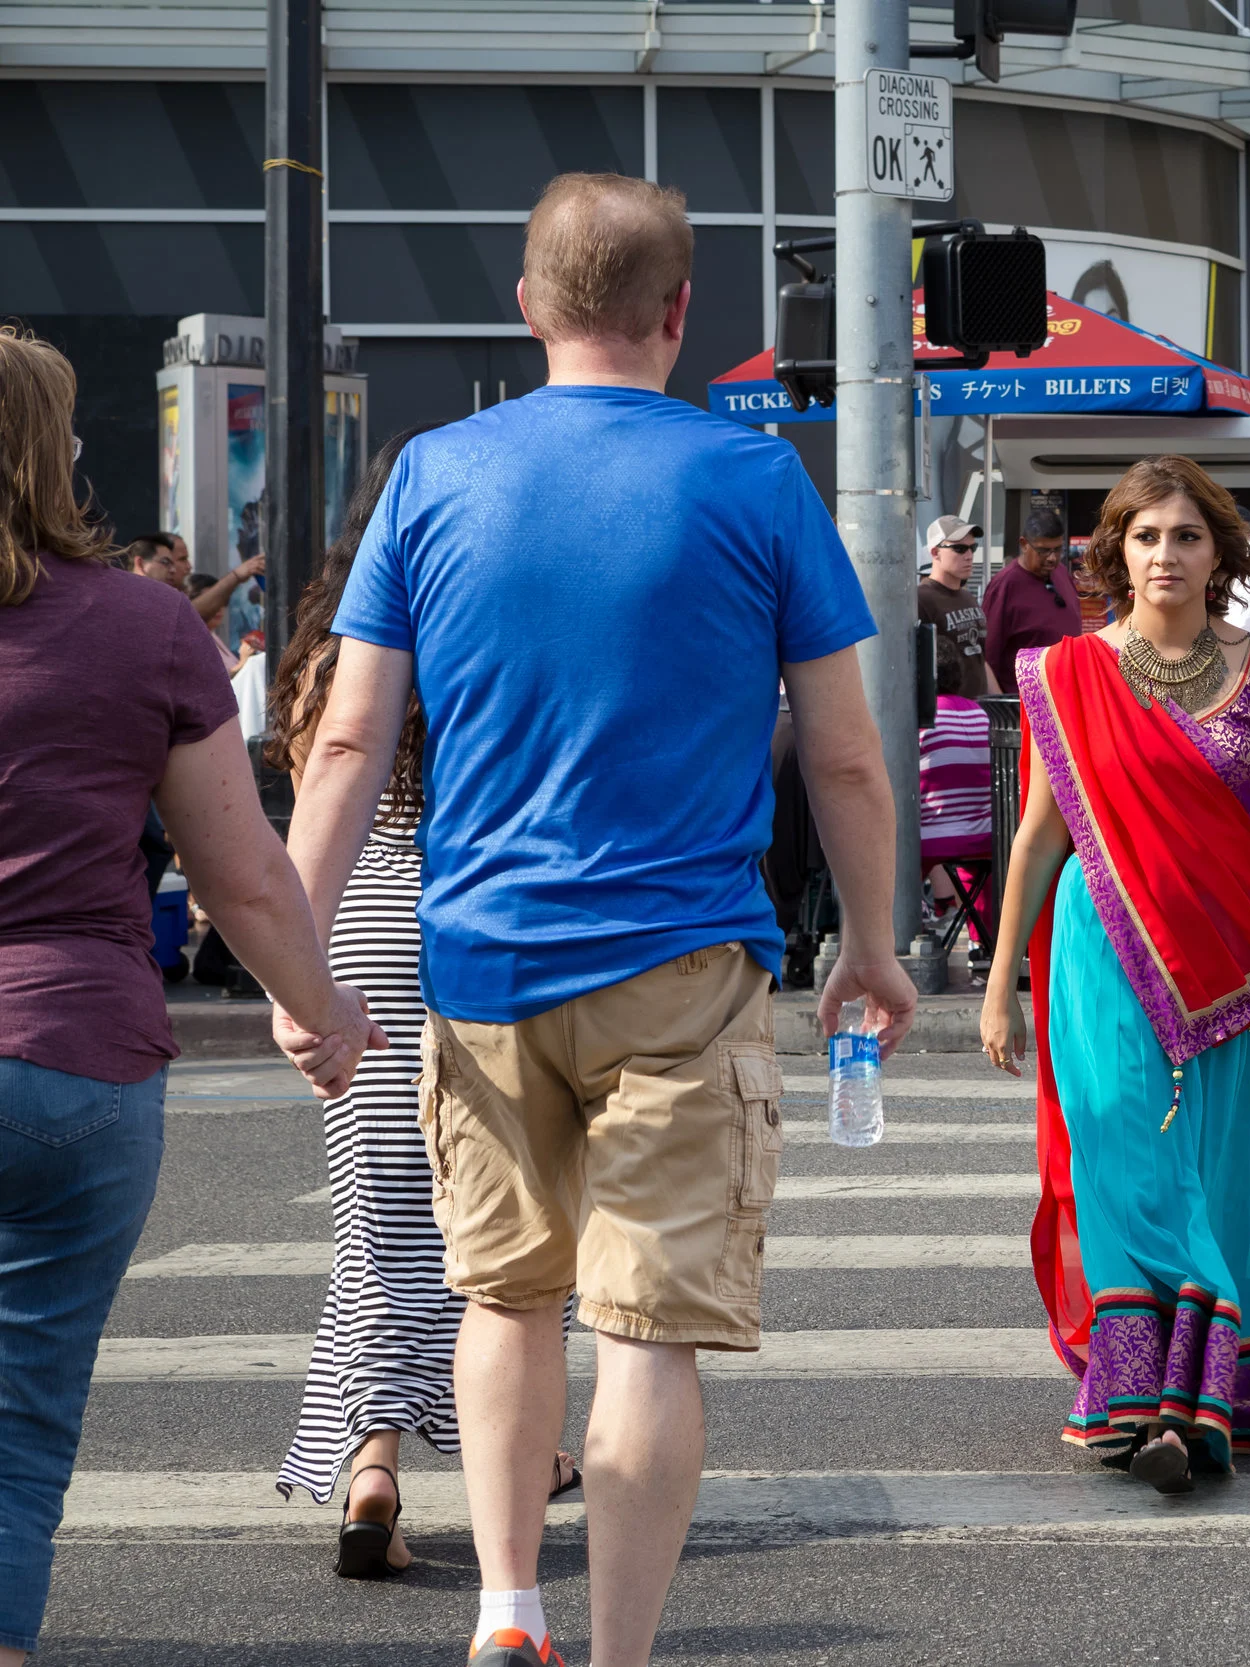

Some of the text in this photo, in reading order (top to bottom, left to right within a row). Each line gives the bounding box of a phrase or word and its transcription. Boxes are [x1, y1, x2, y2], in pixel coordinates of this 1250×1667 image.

[879, 74, 938, 99] DIAGONAL
[878, 96, 939, 121] CROSSING
[873, 135, 903, 181] OK
[961, 379, 1026, 400] チケット
[1045, 378, 1131, 396] BILLETS
[1151, 376, 1189, 396] 티켓
[725, 387, 815, 412] TICKE
